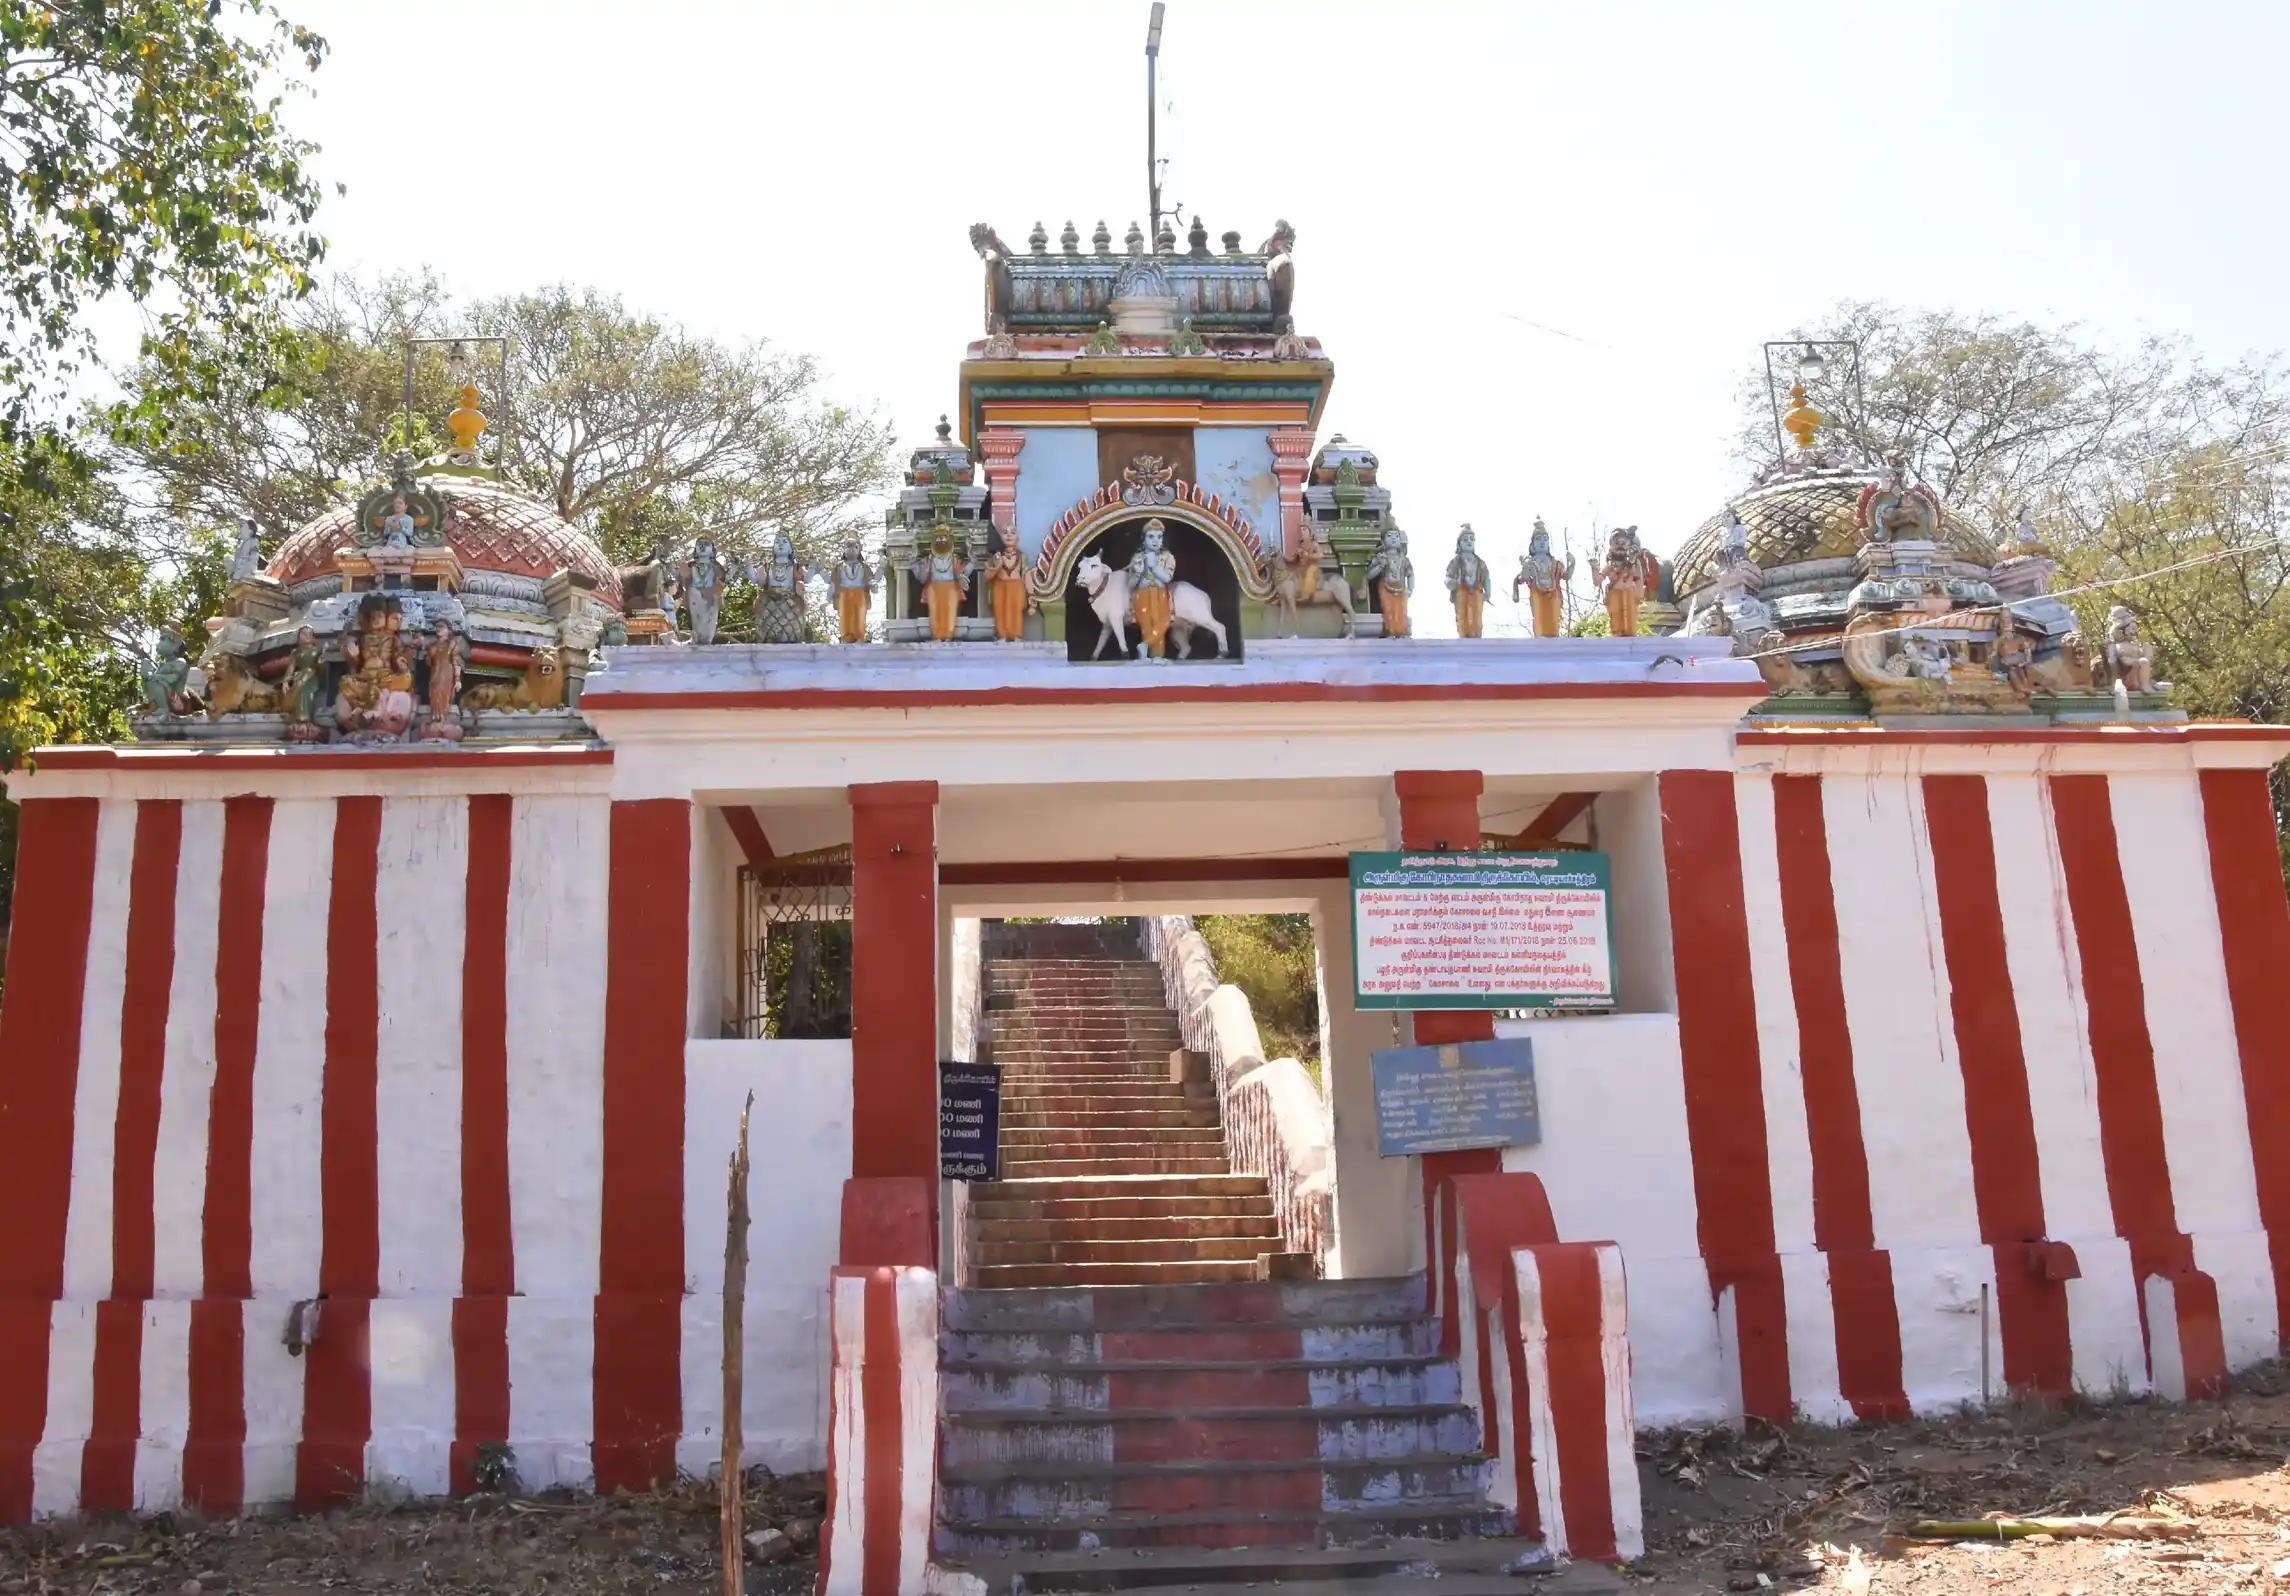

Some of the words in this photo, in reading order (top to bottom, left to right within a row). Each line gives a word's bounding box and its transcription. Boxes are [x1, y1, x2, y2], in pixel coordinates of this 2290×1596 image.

[1360, 892, 1392, 903] திண்டுக்கல்
[1394, 892, 1421, 901] மாவட்டம்
[1471, 892, 1501, 903] அருள்மிகு
[1370, 935, 1405, 946] திண்டுக்கல்
[1448, 950, 1481, 961] திண்டுக்கல்
[1392, 964, 1422, 975] அருள்மிகு
[954, 1099, 981, 1109] மணி
[956, 1114, 983, 1124] மணி
[953, 1129, 980, 1138] மணி
